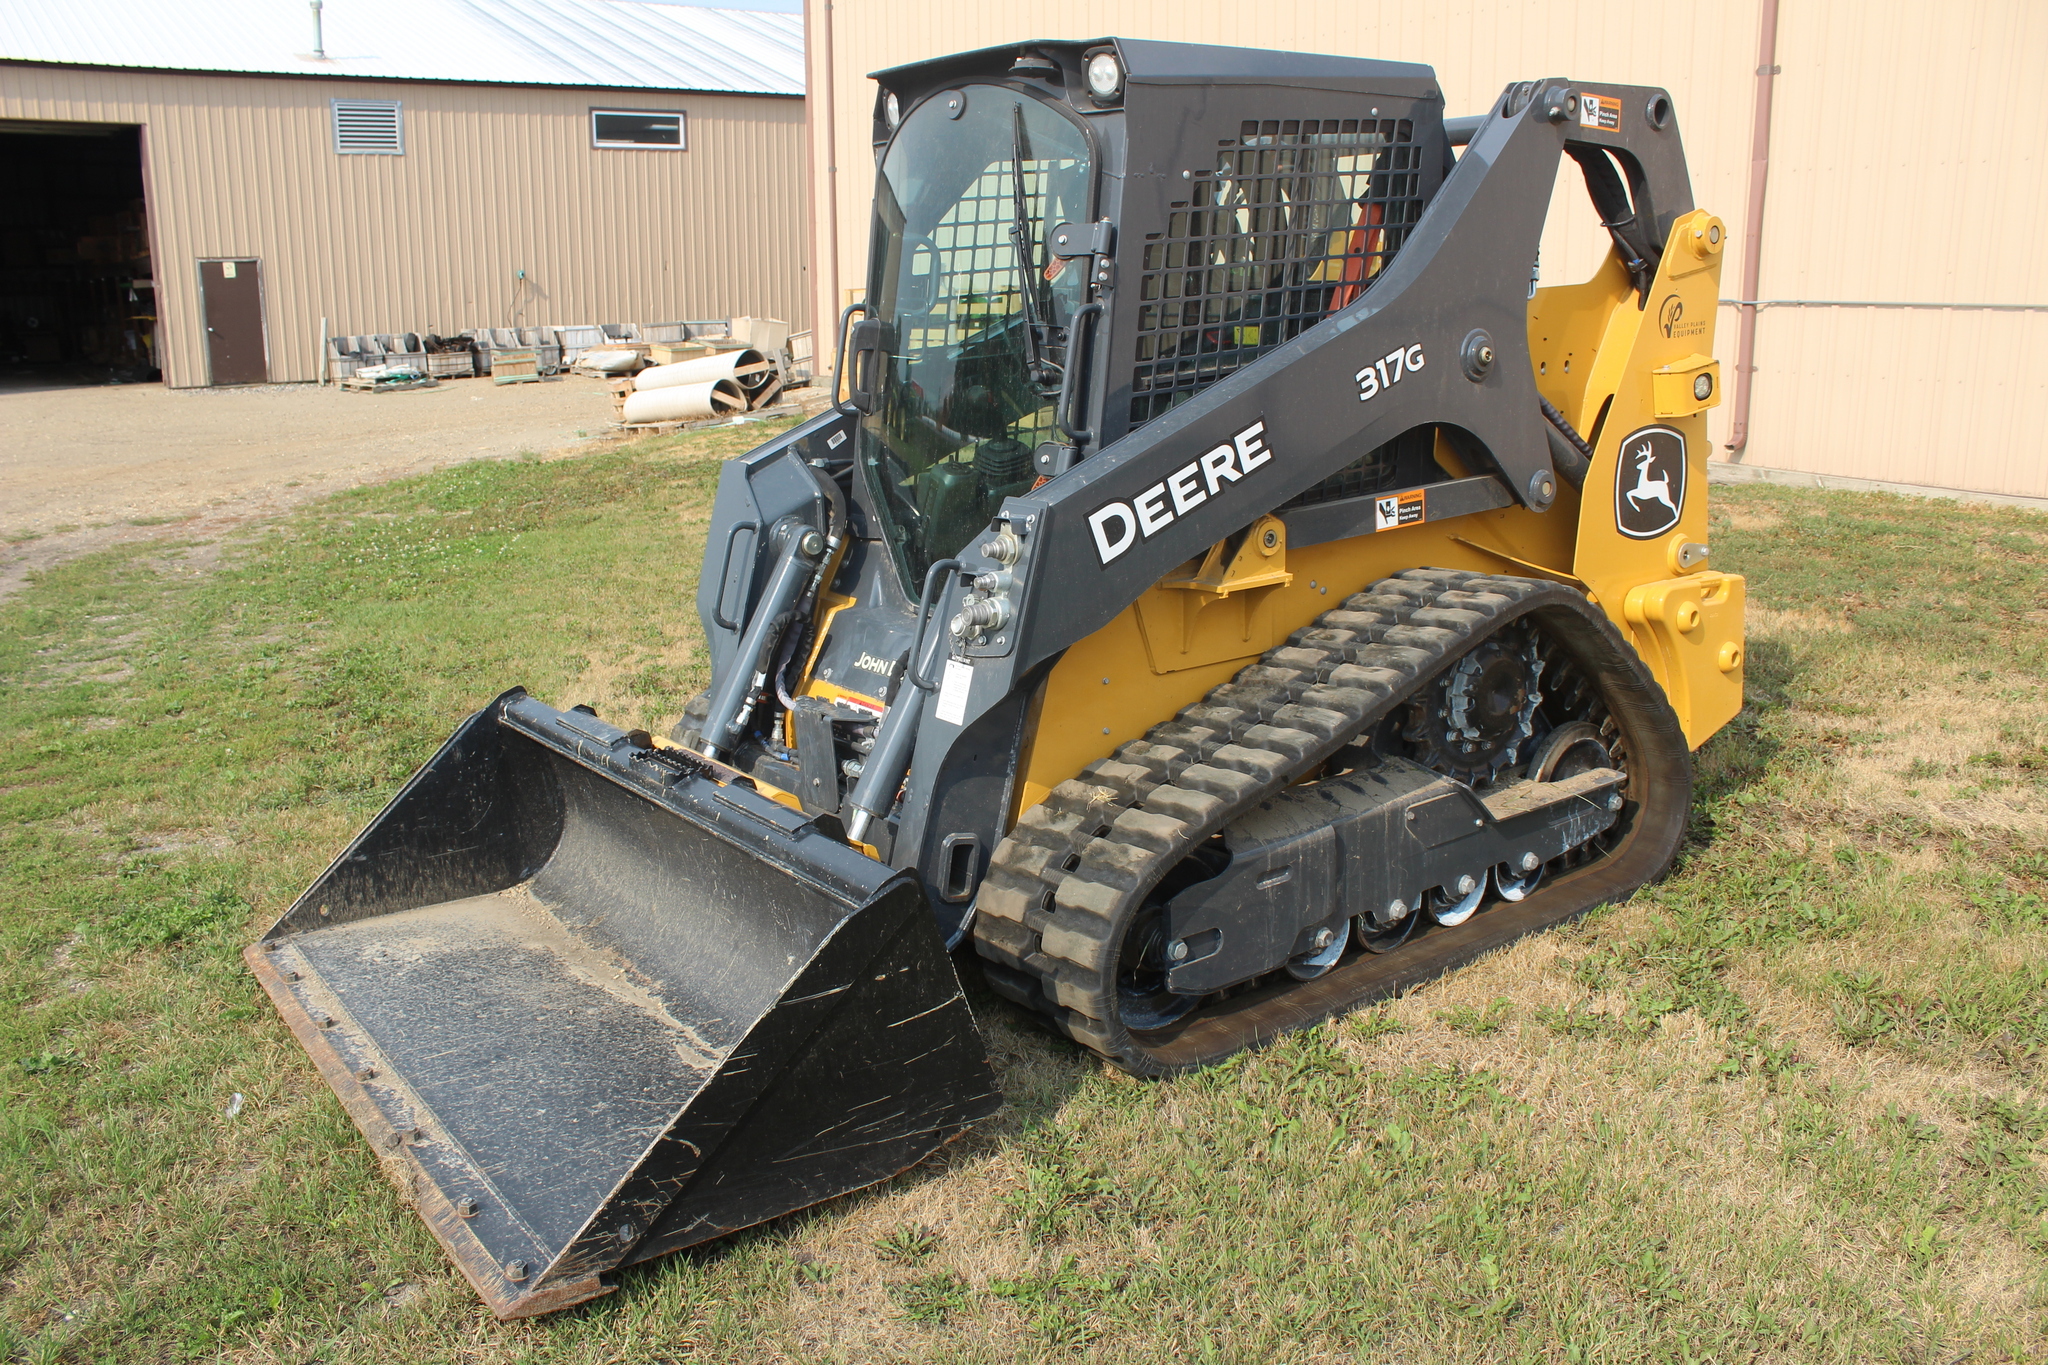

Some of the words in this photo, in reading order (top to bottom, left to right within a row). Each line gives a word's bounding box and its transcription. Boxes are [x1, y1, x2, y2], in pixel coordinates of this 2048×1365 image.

[1673, 327, 1706, 339] EQUIPMENT
[1355, 343, 1425, 401] 317G
[1088, 421, 1272, 565] DEERE
[854, 651, 889, 675] JOHN
